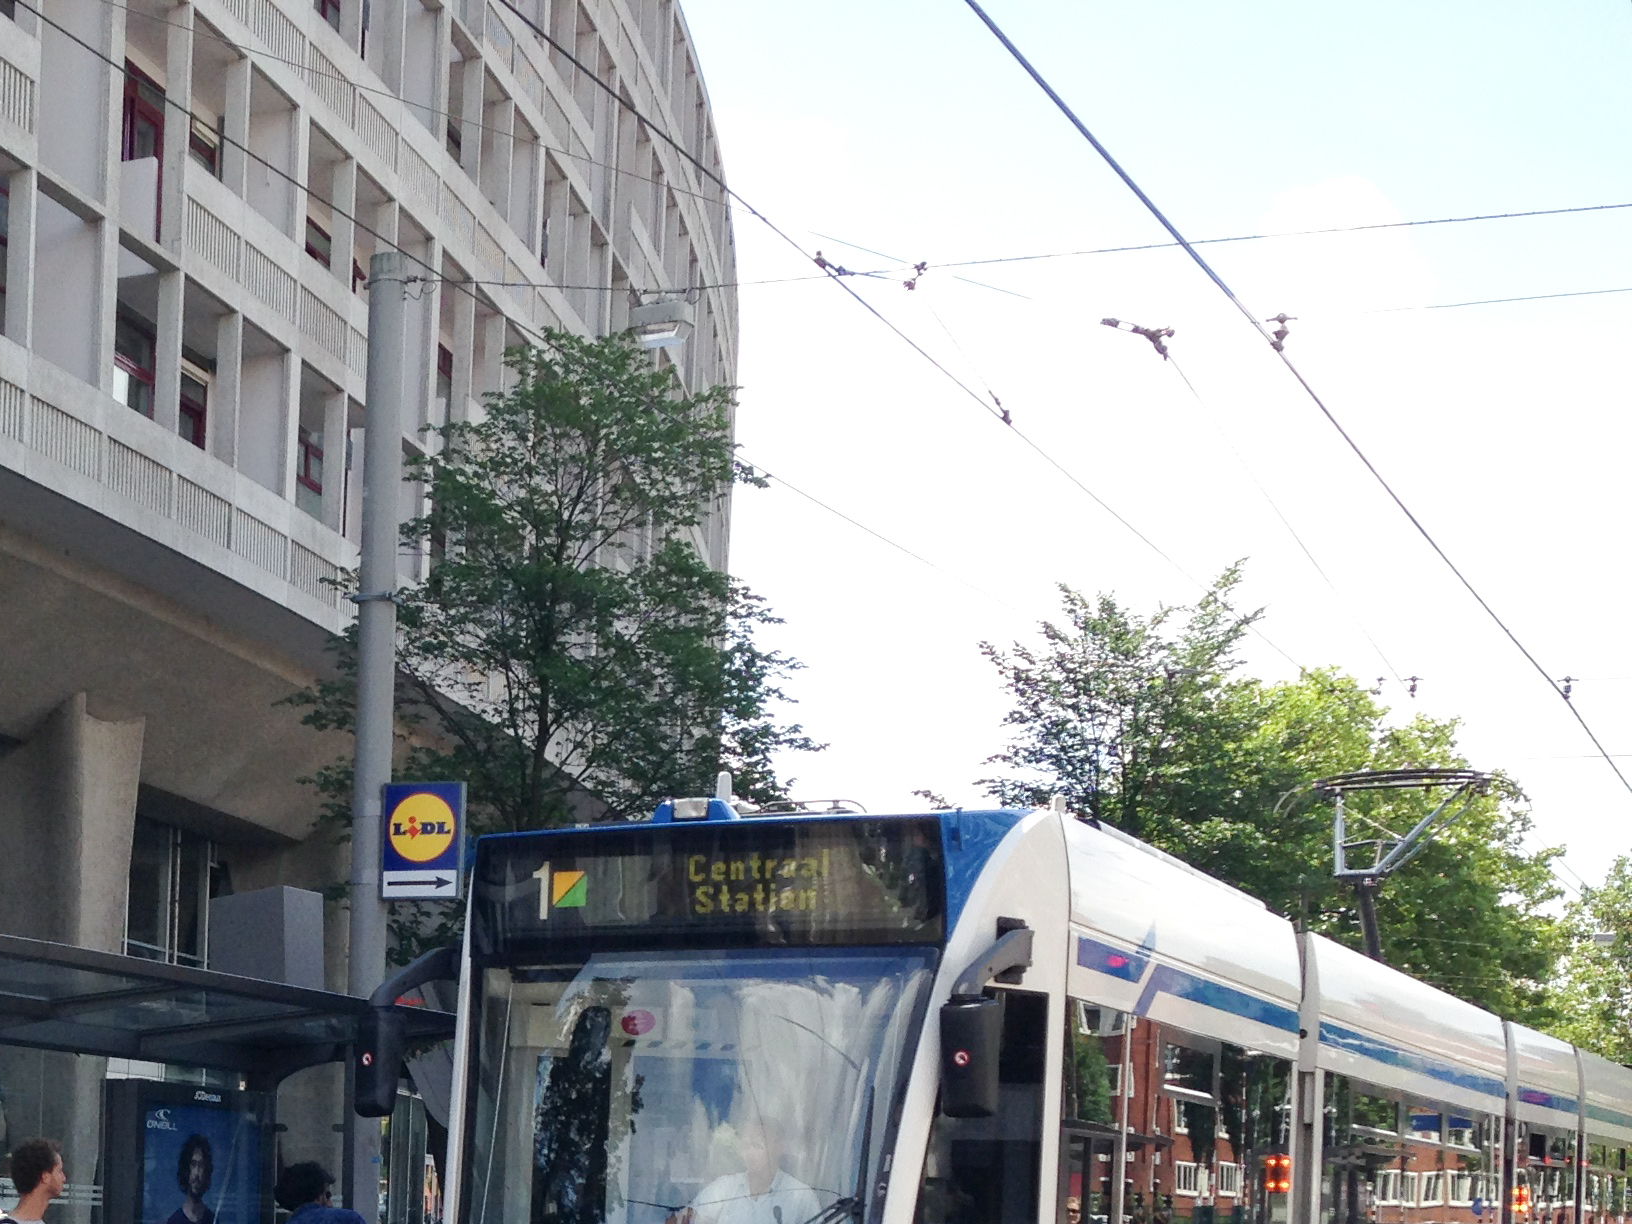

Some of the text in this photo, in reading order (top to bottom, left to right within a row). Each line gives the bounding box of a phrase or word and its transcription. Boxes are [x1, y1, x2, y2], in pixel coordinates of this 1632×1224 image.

[532, 848, 830, 920] 1 Centraal
[694, 883, 818, 914] Station
